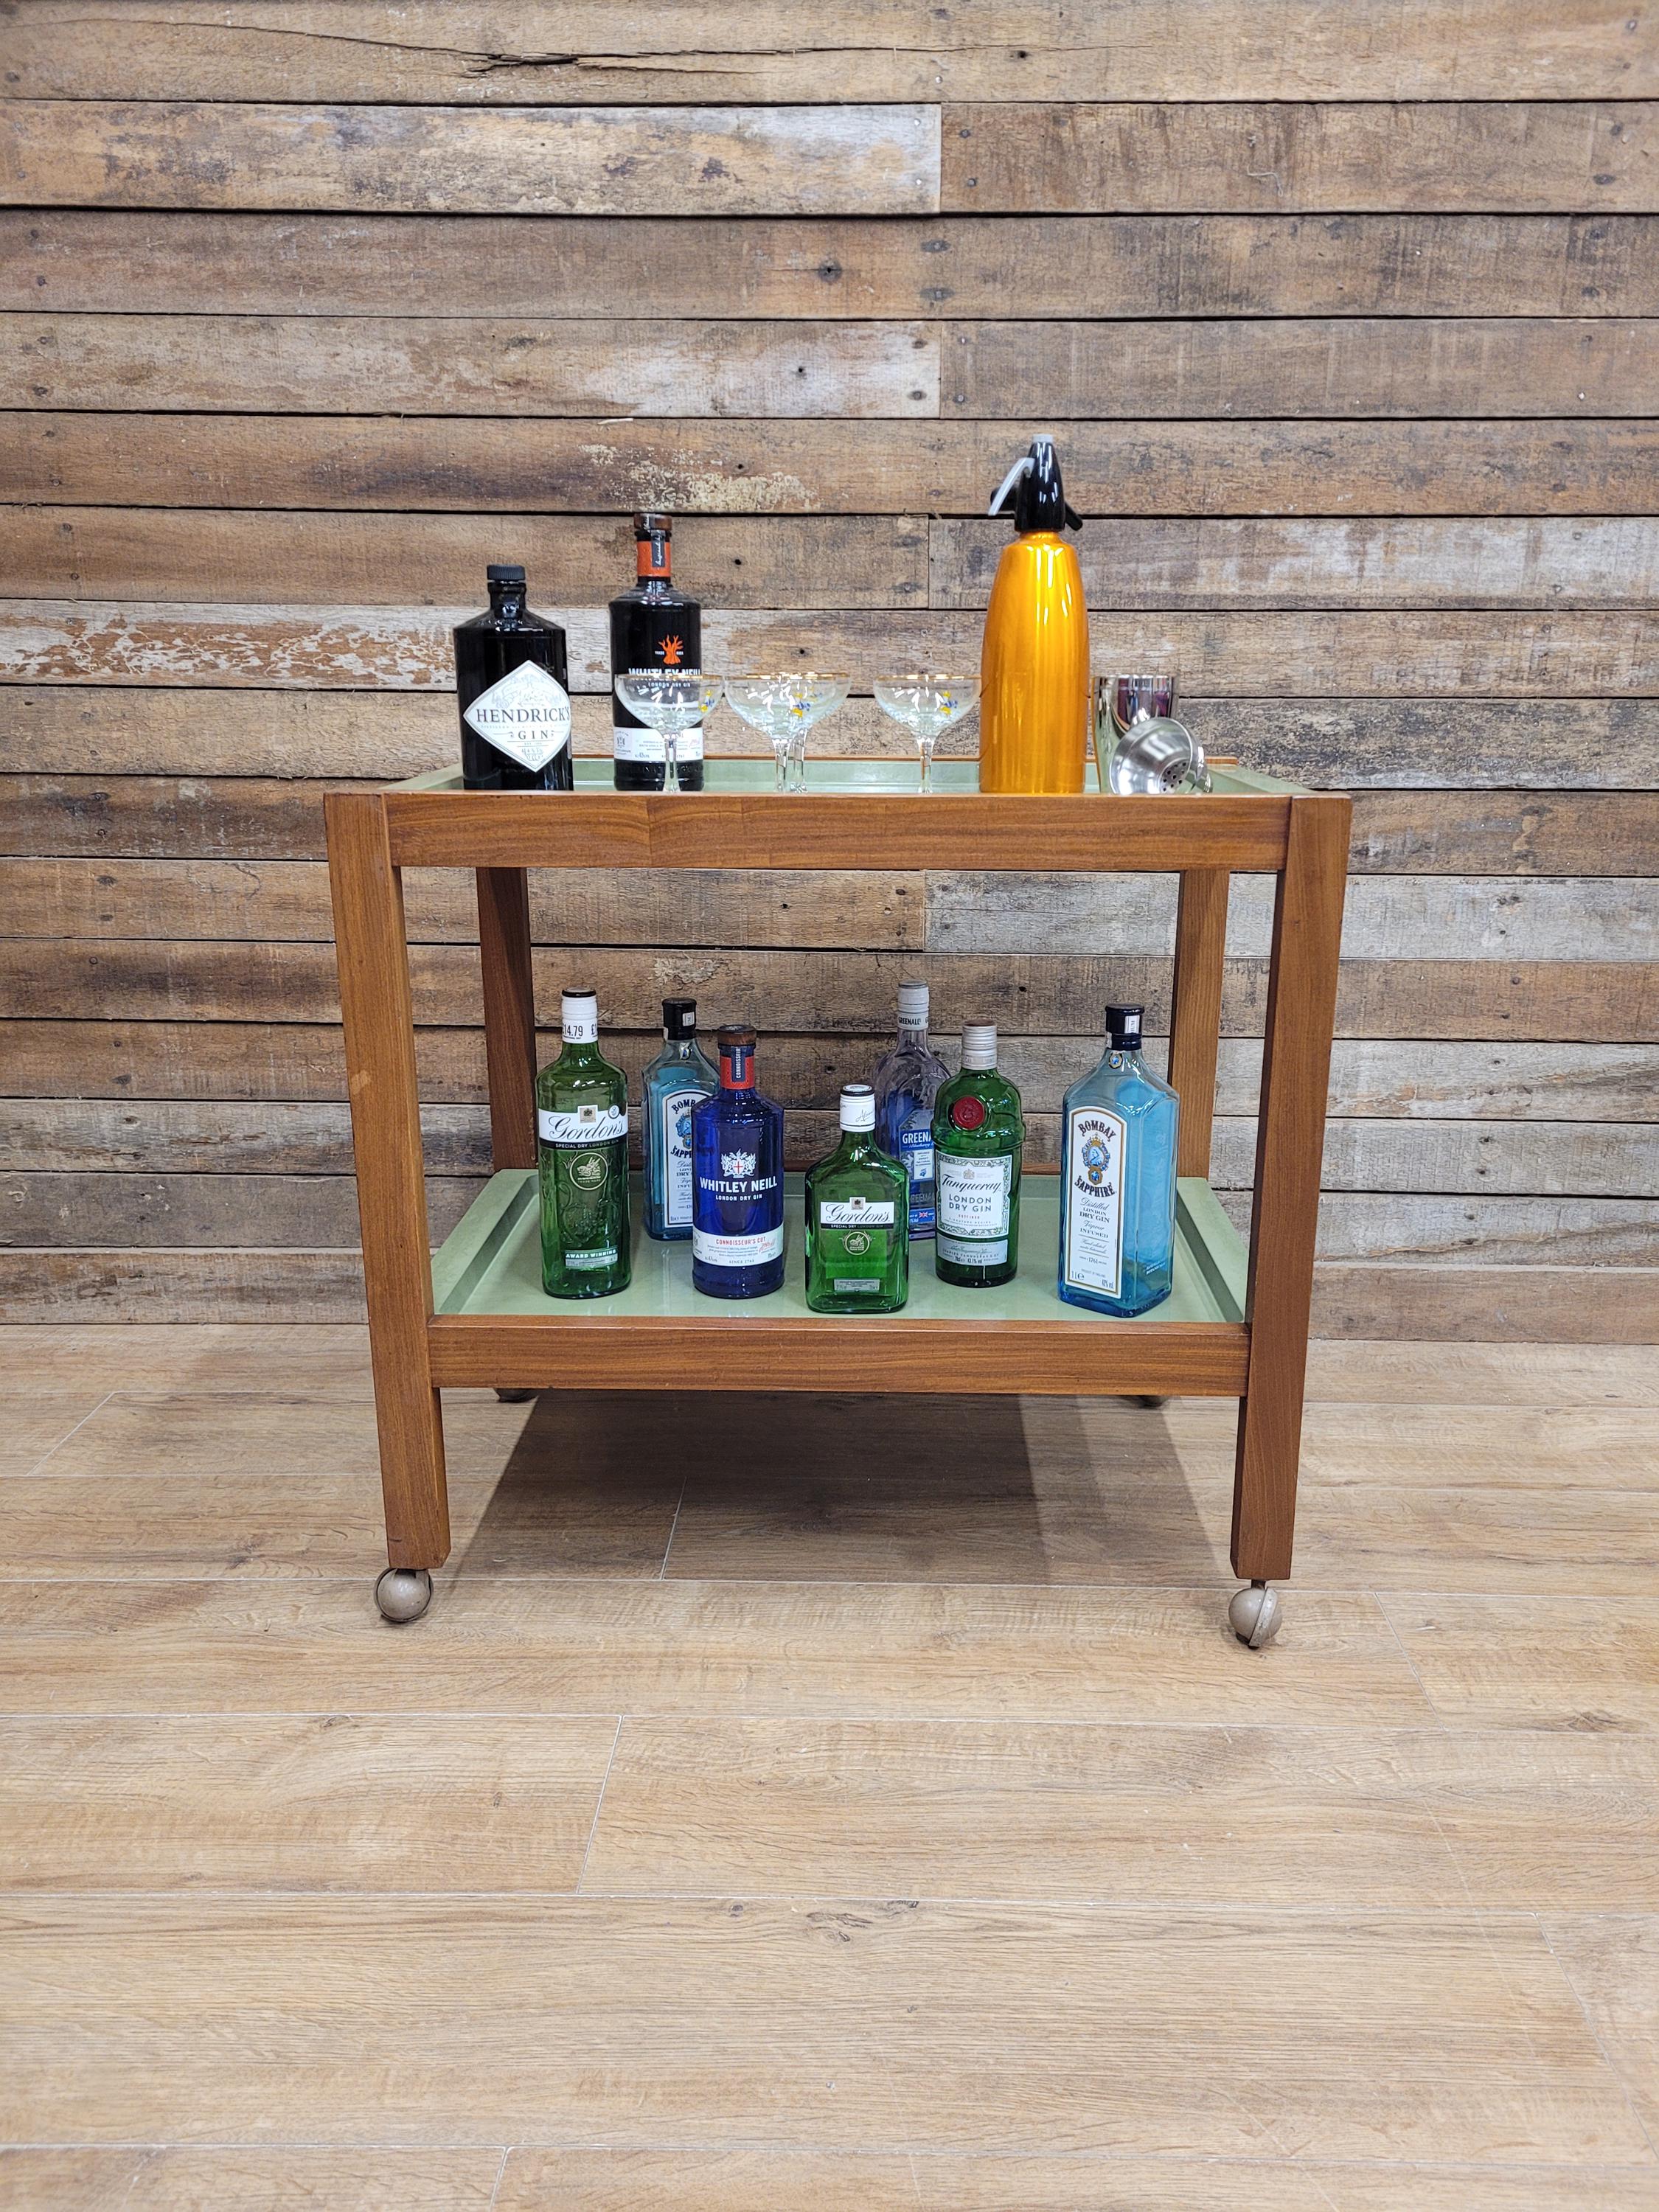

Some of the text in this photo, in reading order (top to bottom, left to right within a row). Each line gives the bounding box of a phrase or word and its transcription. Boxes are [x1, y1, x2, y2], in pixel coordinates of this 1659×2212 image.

[518, 730, 549, 740] GIN
[671, 1099, 697, 1115] BOMB
[548, 1116, 624, 1140] Gordon's
[1078, 1120, 1116, 1142] BOMBAY
[902, 1131, 931, 1144] GREEN
[670, 1145, 692, 1158] SAPP
[700, 1176, 778, 1193] WHITLEY NEILL
[942, 1174, 1002, 1193] Tanqueray
[1074, 1175, 1116, 1197] SAPPHIRE
[949, 1194, 992, 1204] LONDON
[825, 1203, 890, 1222] Gordon's
[949, 1202, 967, 1211] DRY
[1083, 1207, 1107, 1216] LONDON
[1079, 1211, 1110, 1223] DRY GIN
[1080, 1228, 1109, 1239] INFUSED
[590, 1249, 616, 1258] WINNING
[1088, 1256, 1099, 1265] 1761
